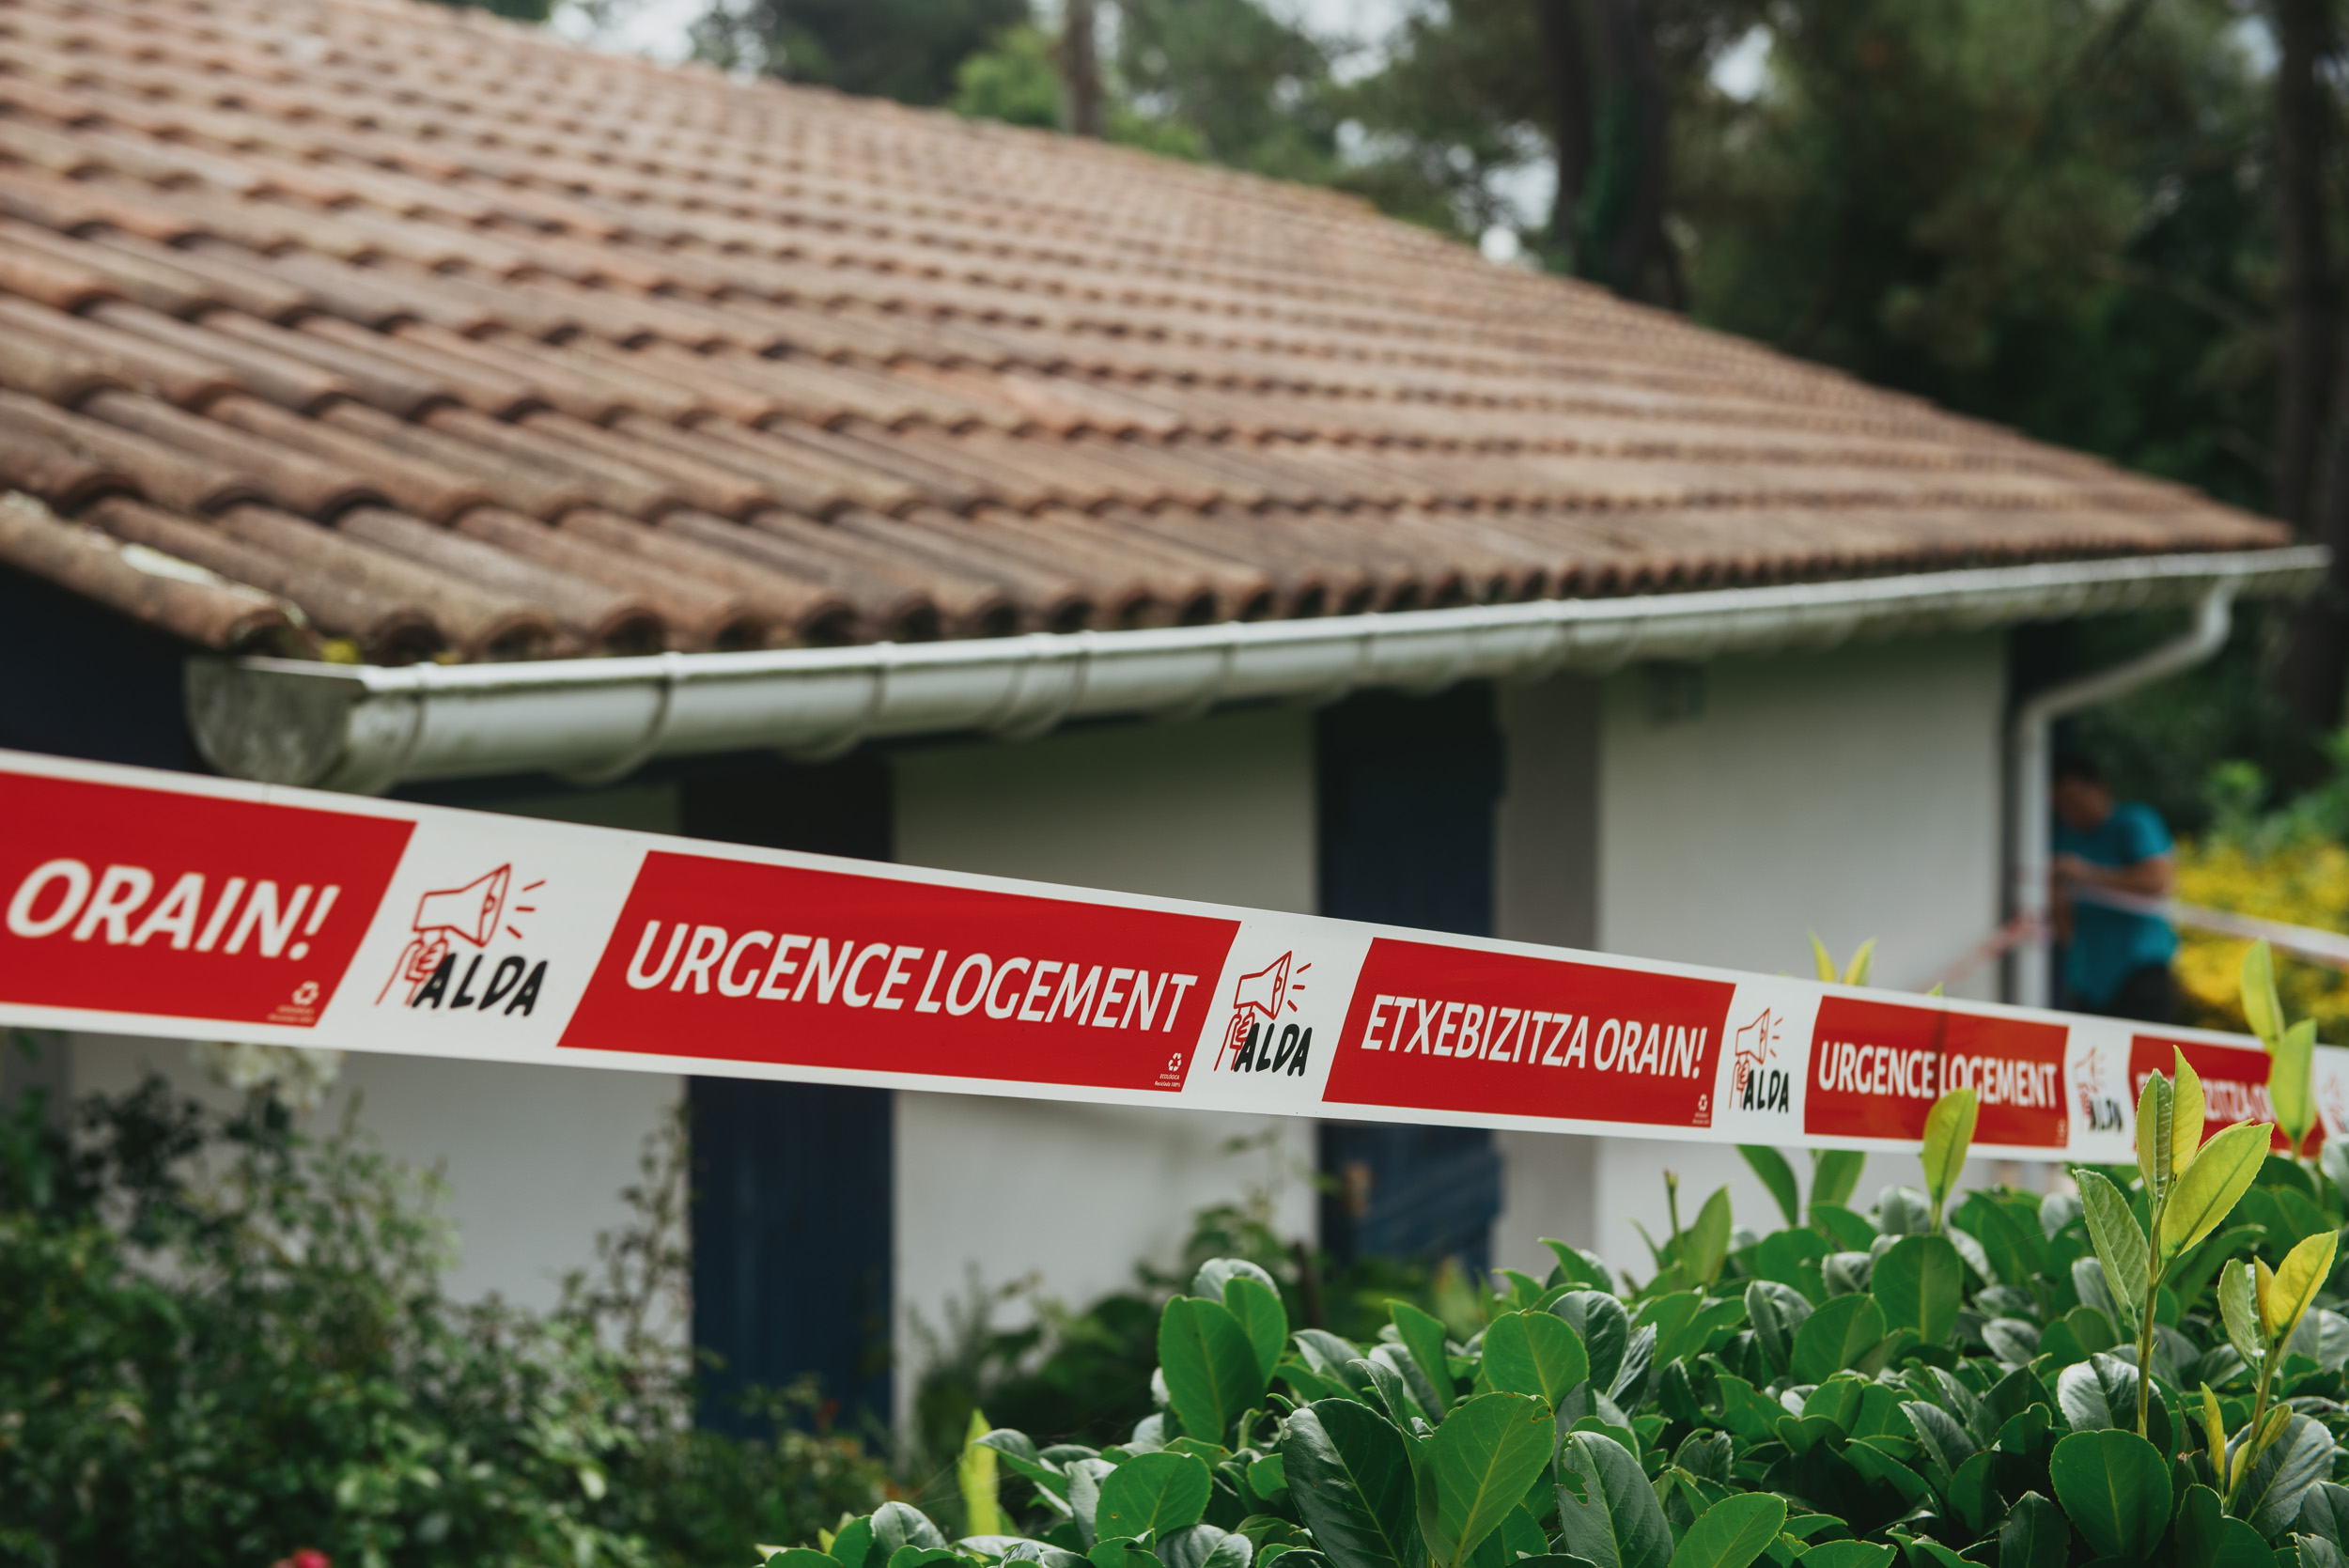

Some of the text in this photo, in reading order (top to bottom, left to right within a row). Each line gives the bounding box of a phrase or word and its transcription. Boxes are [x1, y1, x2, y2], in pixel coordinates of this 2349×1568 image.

[6, 858, 341, 962] ORAIN!
[412, 952, 549, 1017] ALDA
[625, 919, 1200, 1034] URGENCE LOGEMENT
[1233, 1022, 1314, 1079] ALDA
[1361, 993, 1709, 1080] ETXEBIZITZA ORAIN!
[1742, 1068, 1790, 1114] ALDA
[1818, 1040, 2058, 1109] URGENCE LOGEMENT
